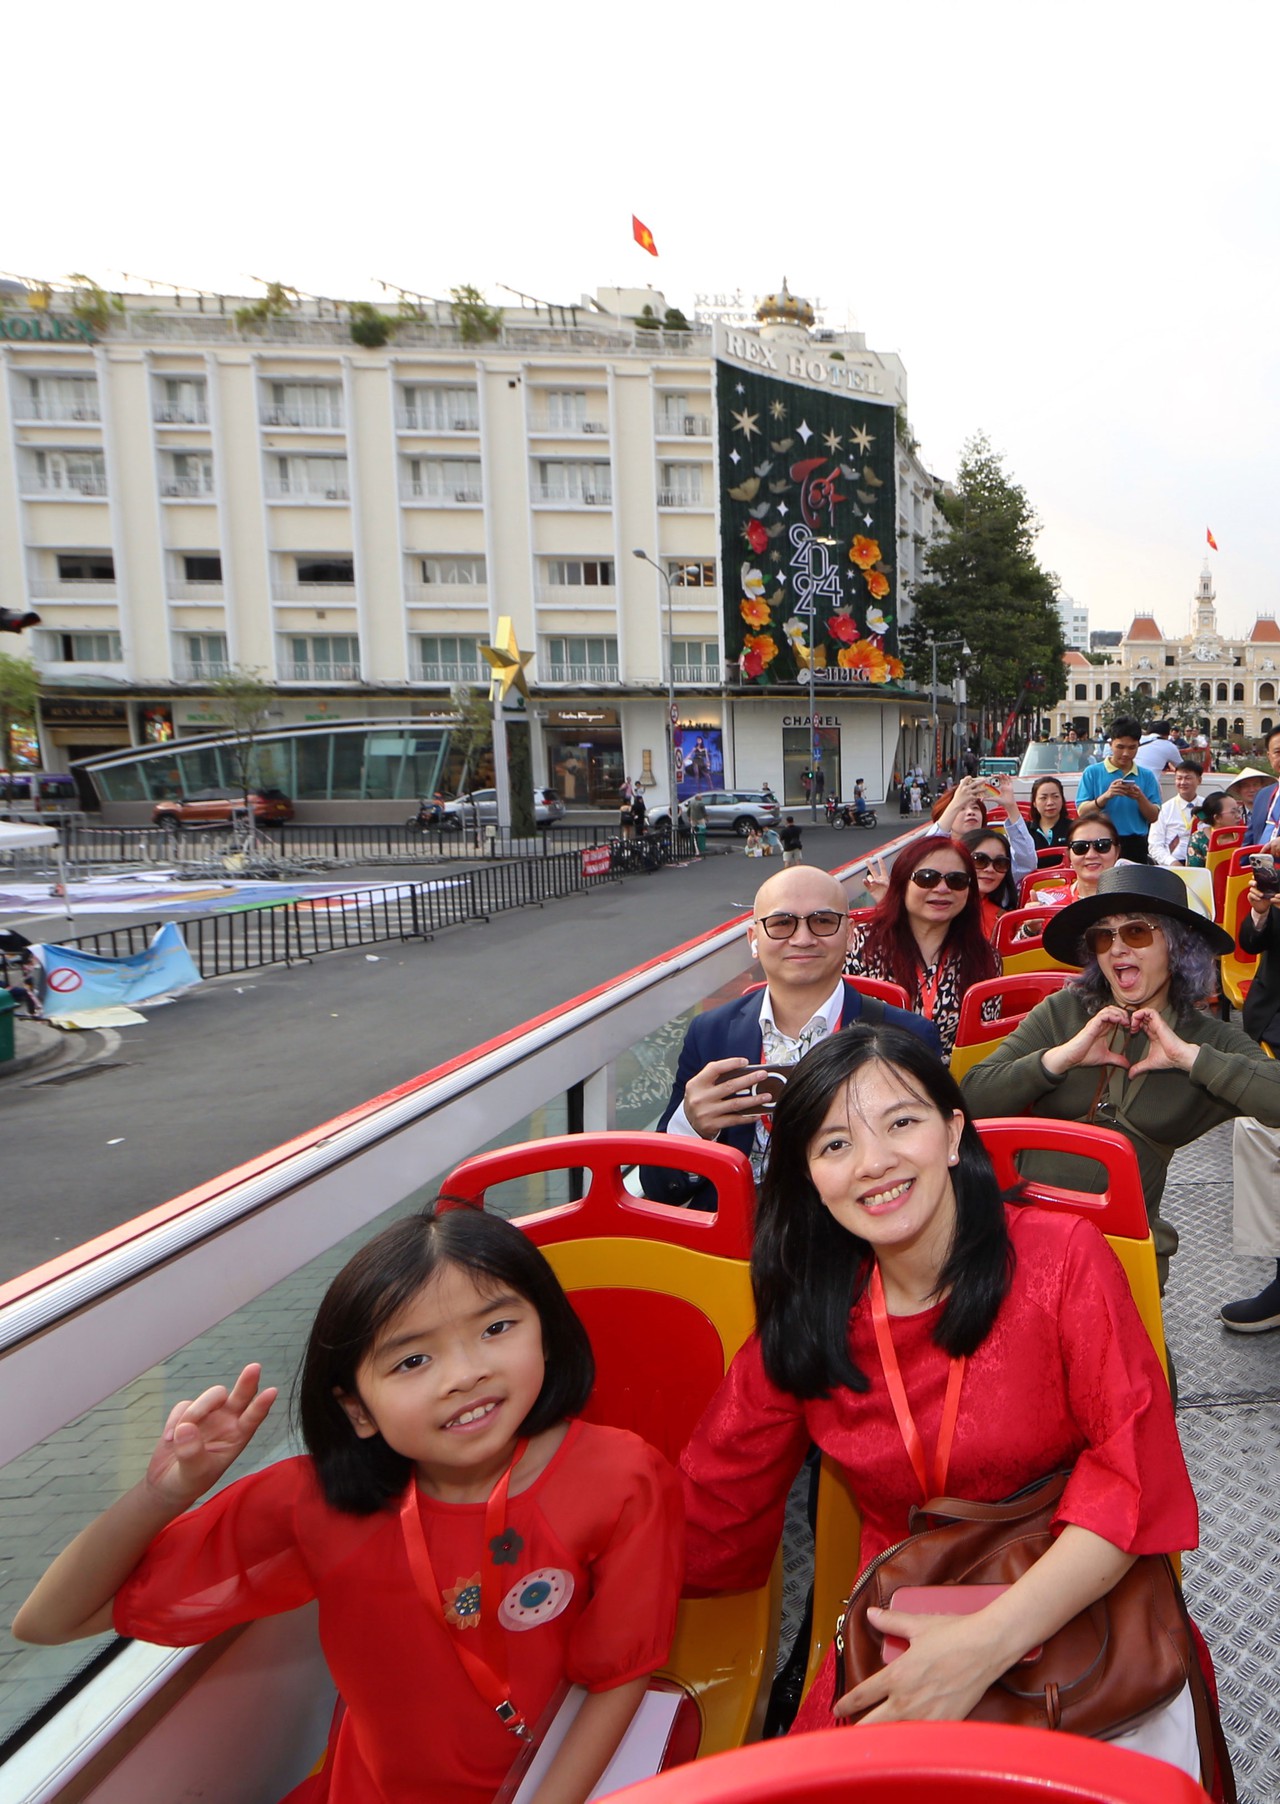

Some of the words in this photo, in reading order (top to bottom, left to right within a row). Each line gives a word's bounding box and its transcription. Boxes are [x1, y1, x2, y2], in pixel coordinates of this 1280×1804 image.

[0, 317, 98, 342] OLEX
[725, 331, 778, 371] REX
[787, 354, 885, 396] HOTEL
